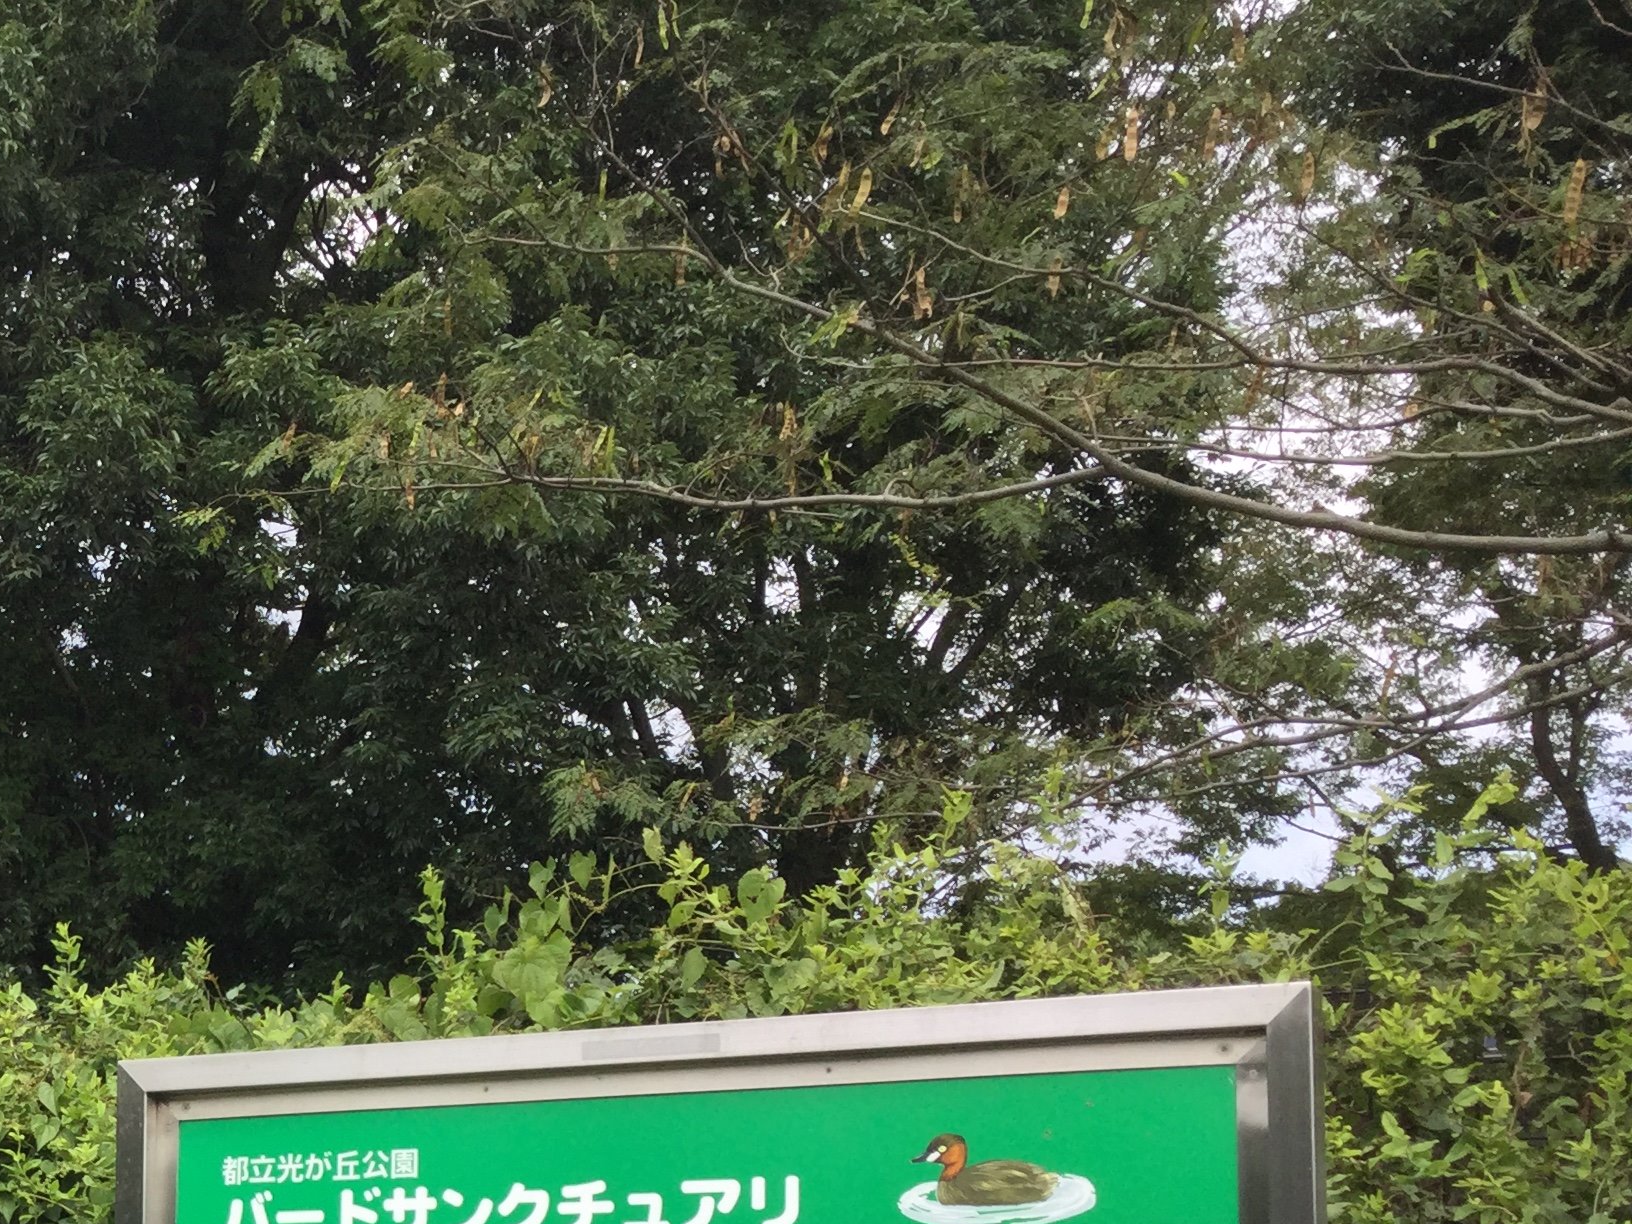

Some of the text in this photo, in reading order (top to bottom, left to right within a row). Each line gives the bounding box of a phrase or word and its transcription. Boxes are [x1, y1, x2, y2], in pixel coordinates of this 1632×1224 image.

[221, 1148, 418, 1185] 都立光が丘公園
